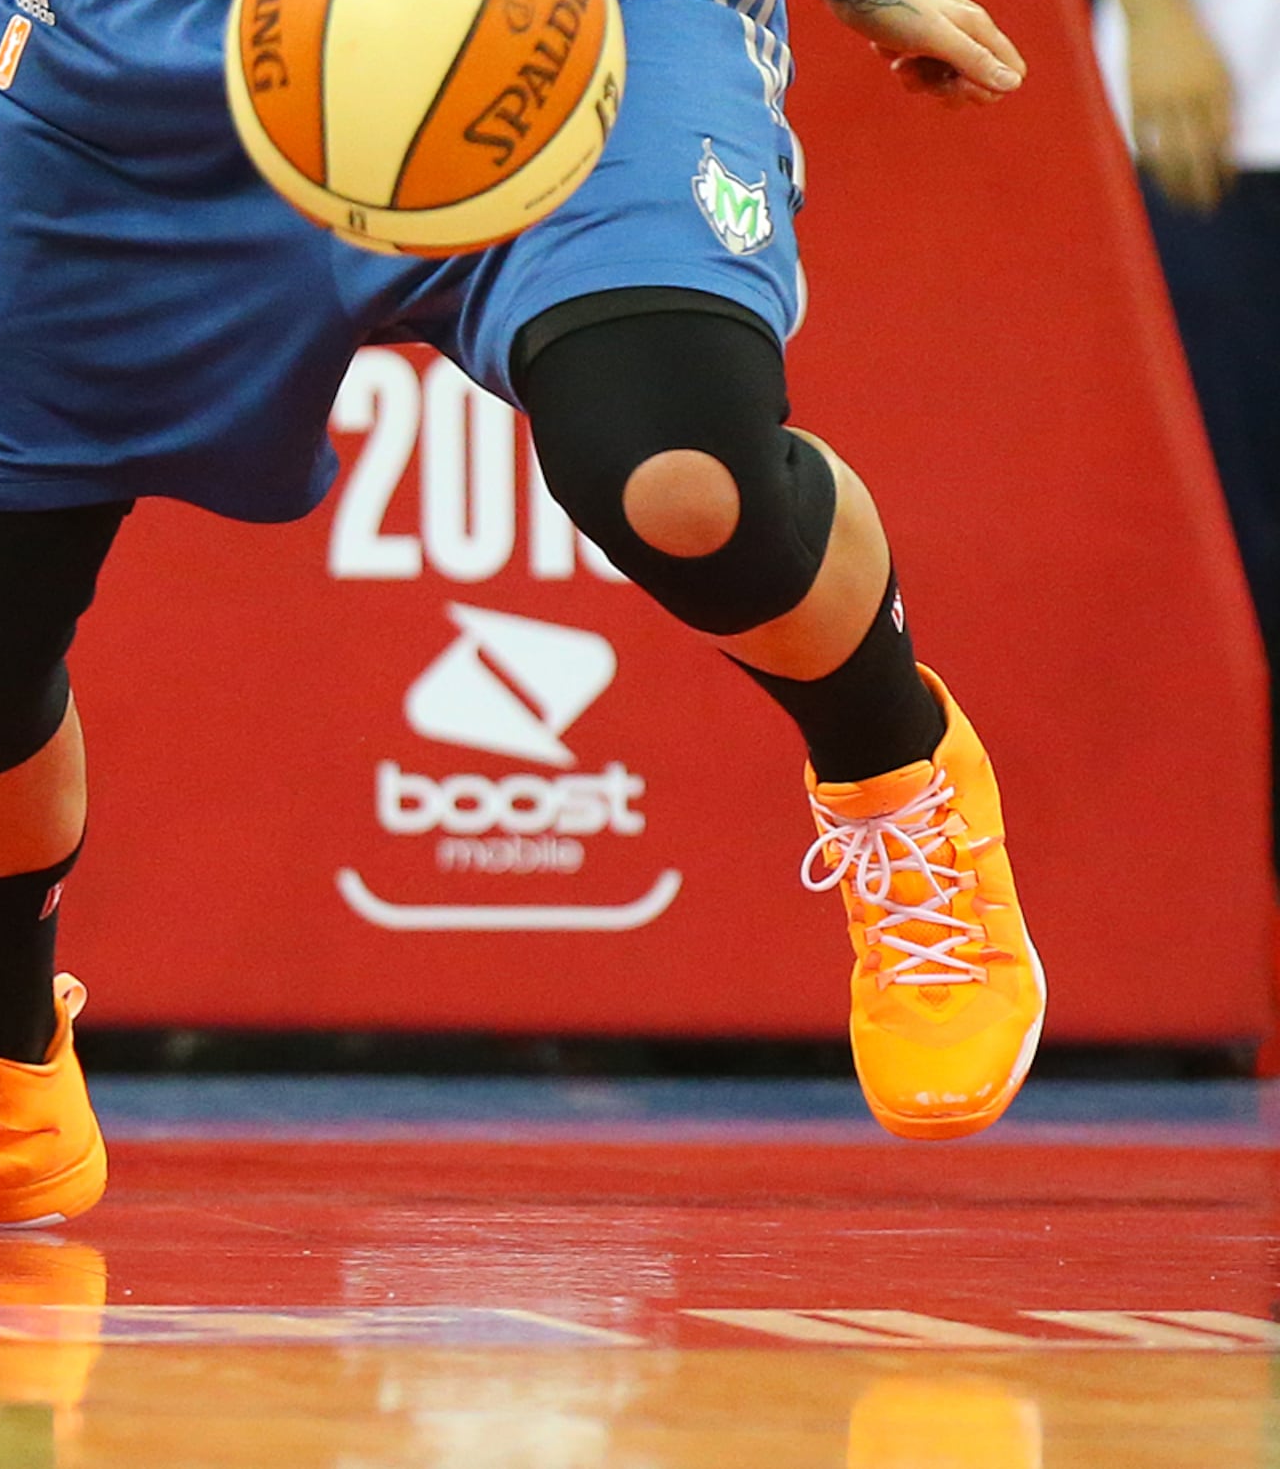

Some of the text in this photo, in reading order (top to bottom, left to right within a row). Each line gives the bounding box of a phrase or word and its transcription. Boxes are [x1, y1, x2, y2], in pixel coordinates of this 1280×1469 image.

[327, 346, 632, 584] 201
[375, 758, 646, 834] boost
[436, 834, 587, 873] mobile
